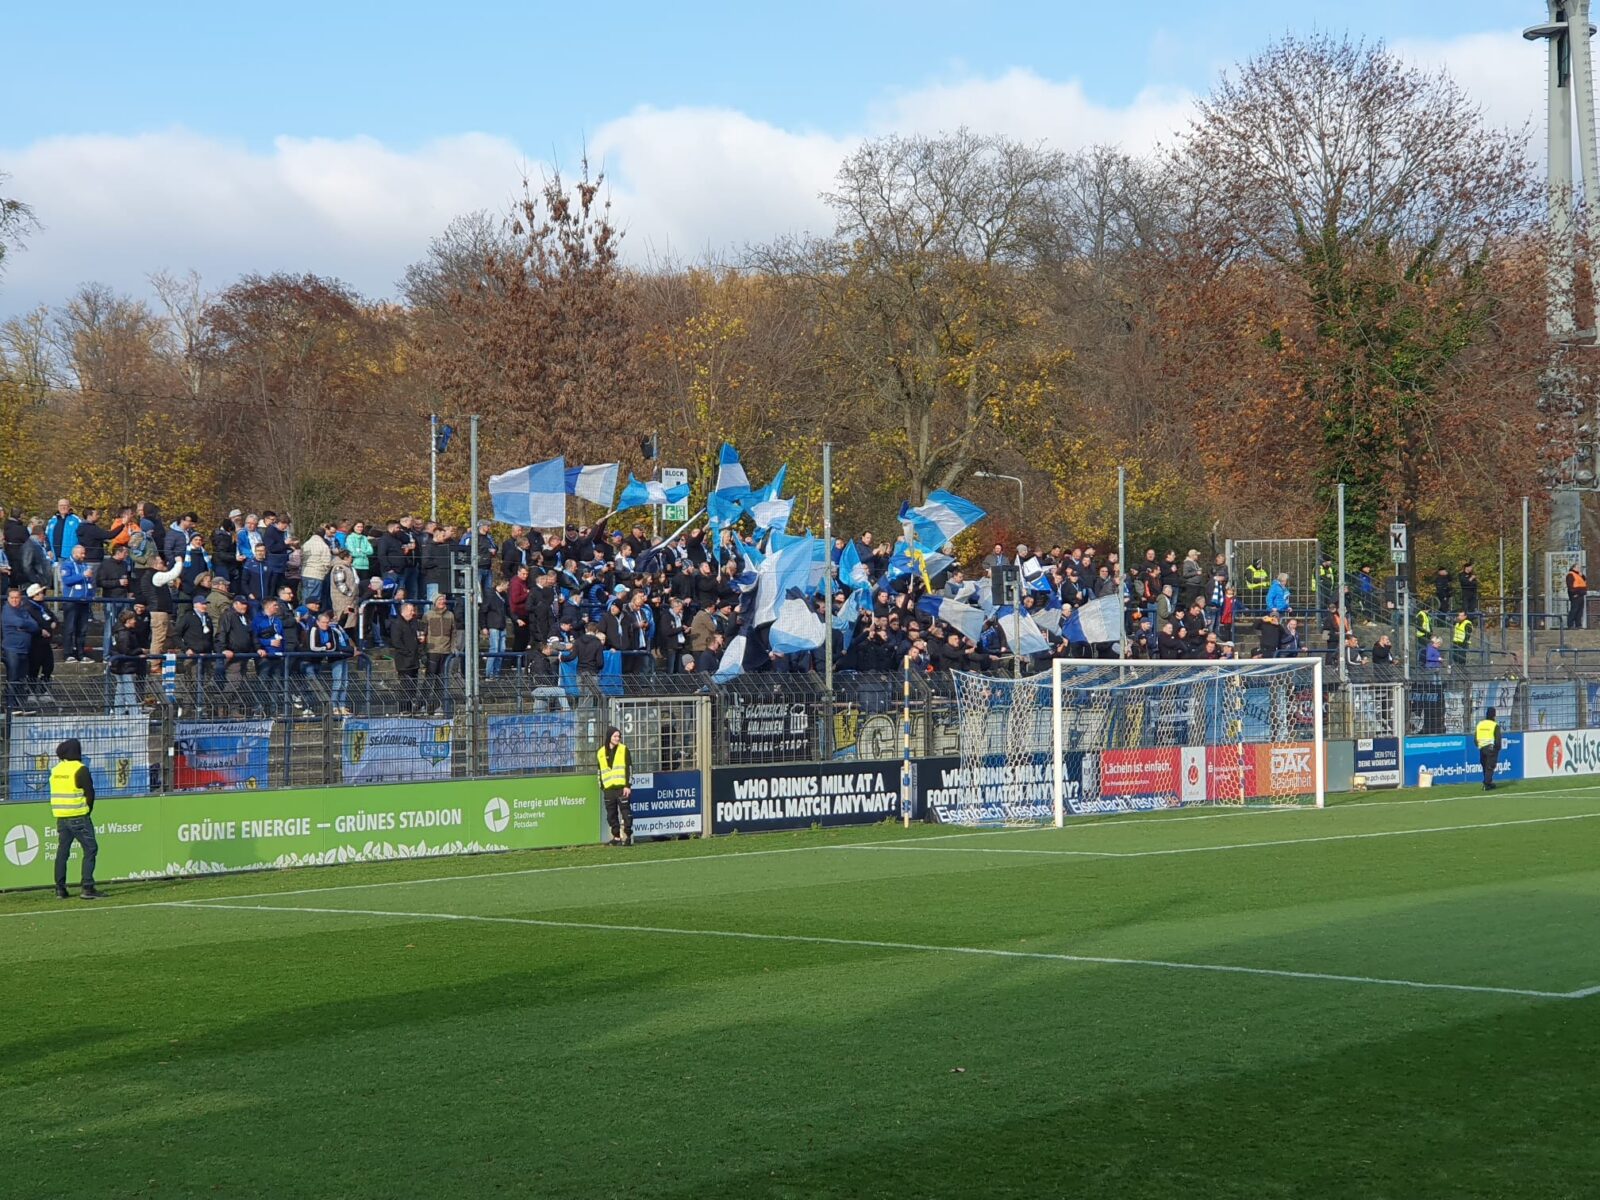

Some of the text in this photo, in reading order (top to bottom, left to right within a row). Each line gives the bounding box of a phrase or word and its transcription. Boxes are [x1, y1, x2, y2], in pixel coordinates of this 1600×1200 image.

[1392, 533, 1403, 548] K
[624, 713, 633, 733] 3
[1105, 760, 1172, 774] Lächeln ist einfach.
[1271, 754, 1311, 774] DAK
[636, 777, 650, 785] PCH
[941, 767, 971, 788] WHO
[973, 765, 1014, 786] DRINKS
[1015, 764, 1042, 783] MILK
[1271, 773, 1312, 789] Gesundheit
[657, 788, 696, 799] DEIN STYLE
[733, 773, 884, 799] WHO DRINKS MILK AT A
[513, 796, 586, 809] Energie und Wasser
[927, 786, 984, 808] FOOTBALL
[985, 783, 1026, 803] MATCH
[651, 799, 696, 811] WORKWEAR
[716, 791, 897, 823] FOOTBALL MATCH ANYWAY?
[1069, 796, 1127, 813] Eisenbach
[513, 811, 545, 820] Stadtwerke
[935, 803, 1006, 823] Eisenbach
[107, 822, 143, 834] Wasser
[177, 818, 236, 842] GRÜNE
[241, 817, 310, 839] ENERGIE
[335, 810, 395, 833] GRÜNES
[399, 808, 462, 829] STADION
[513, 821, 538, 829] Potsdam
